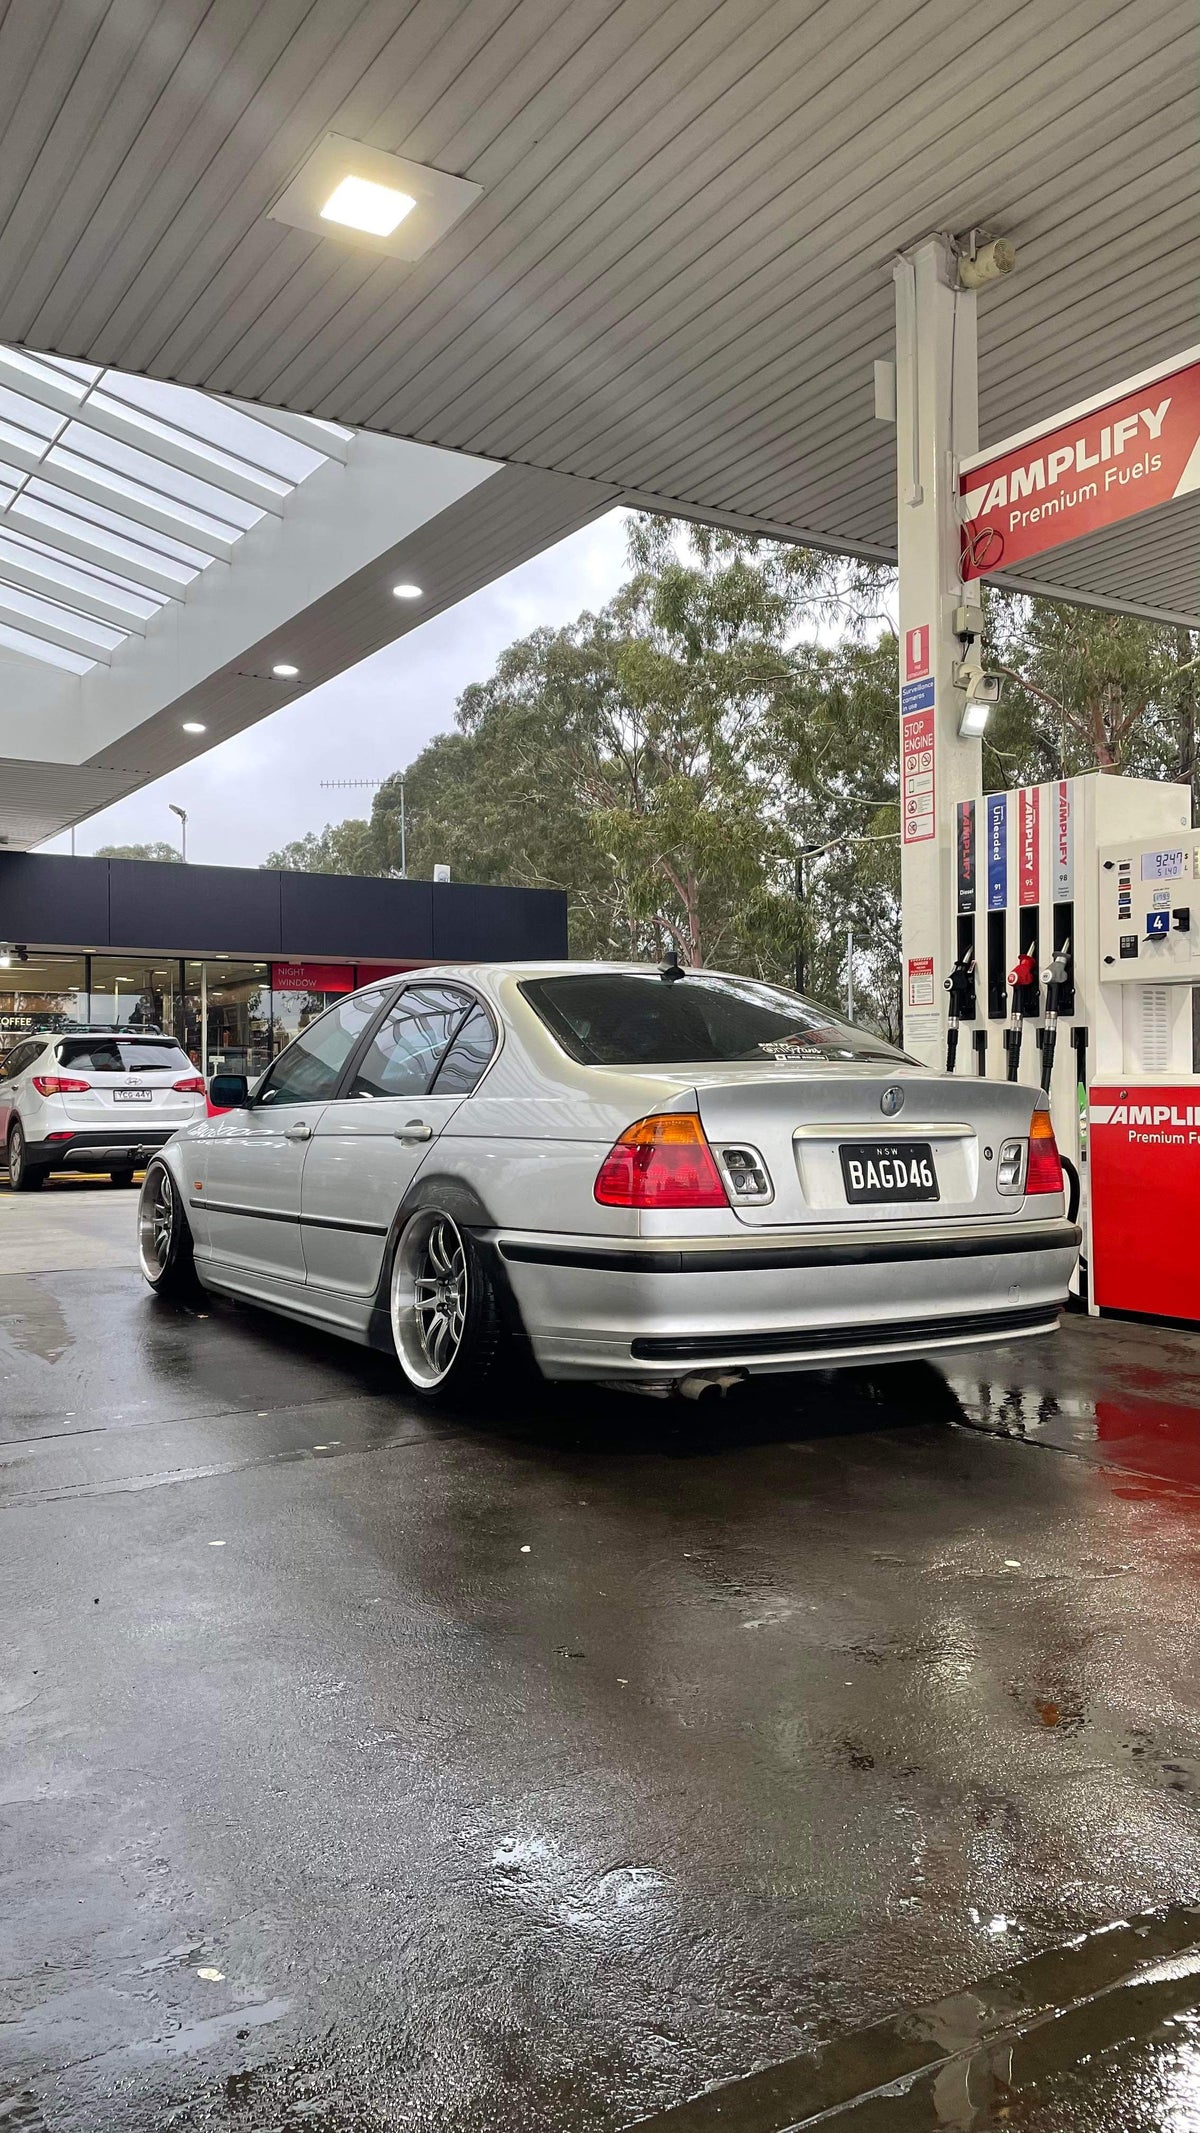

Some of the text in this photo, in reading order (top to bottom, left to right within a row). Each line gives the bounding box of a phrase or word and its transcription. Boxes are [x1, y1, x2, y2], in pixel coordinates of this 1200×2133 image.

[981, 397, 1173, 516] AMPLIFY
[1009, 451, 1162, 533] Premium Fuels
[902, 681, 934, 696] Surveillance
[902, 692, 926, 706] cameras
[908, 702, 918, 711] use
[904, 720, 925, 738] STOP
[904, 732, 934, 753] ENGINE
[993, 805, 1001, 861] Unleaded
[1025, 803, 1034, 871] AMPLIFY
[1060, 797, 1068, 866] AMPLIFY
[962, 813, 971, 881] AMPLIFY
[1025, 879, 1034, 887] 95
[1059, 874, 1068, 882] 98
[959, 887, 974, 896] Diesel
[1153, 915, 1163, 929] 4
[278, 968, 305, 976] NIGHT
[278, 979, 317, 987] WINDOW
[0, 1016, 33, 1026] OFFEE
[1128, 1130, 1200, 1145] Premium F
[876, 1147, 898, 1156] NSW
[848, 1159, 933, 1189] BAGD46
